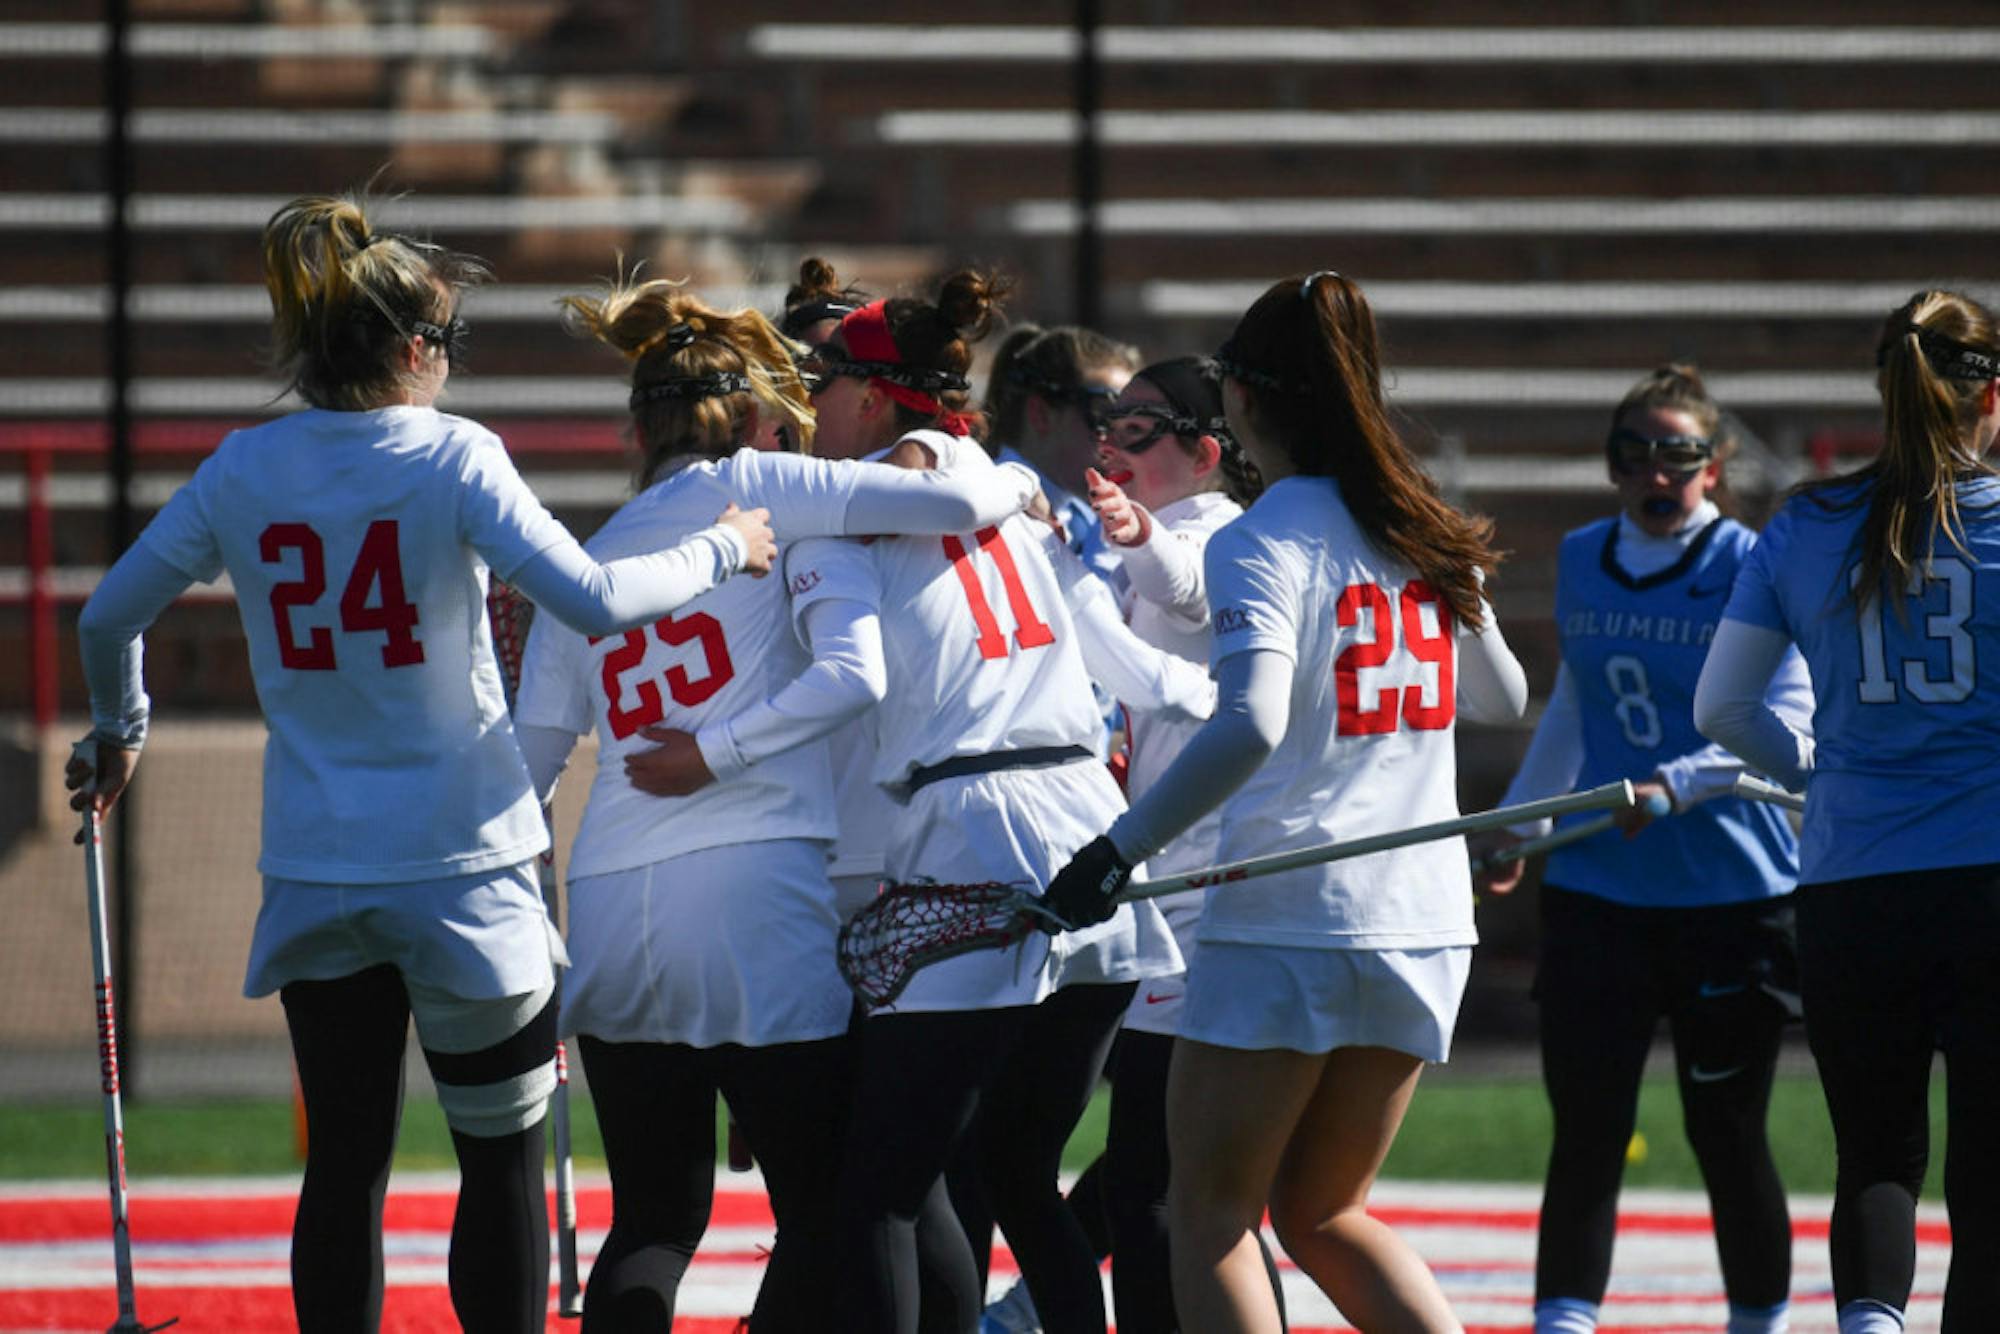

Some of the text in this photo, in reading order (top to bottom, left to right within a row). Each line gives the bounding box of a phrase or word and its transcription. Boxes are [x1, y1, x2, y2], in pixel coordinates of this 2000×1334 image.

[258, 519, 425, 671] 24
[942, 523, 1056, 660] 11
[1334, 579, 1456, 737] 29
[1565, 611, 1716, 645] OLUMBIA
[1849, 556, 1976, 704] 13
[587, 611, 735, 741] 25
[1604, 654, 1663, 748] 8
